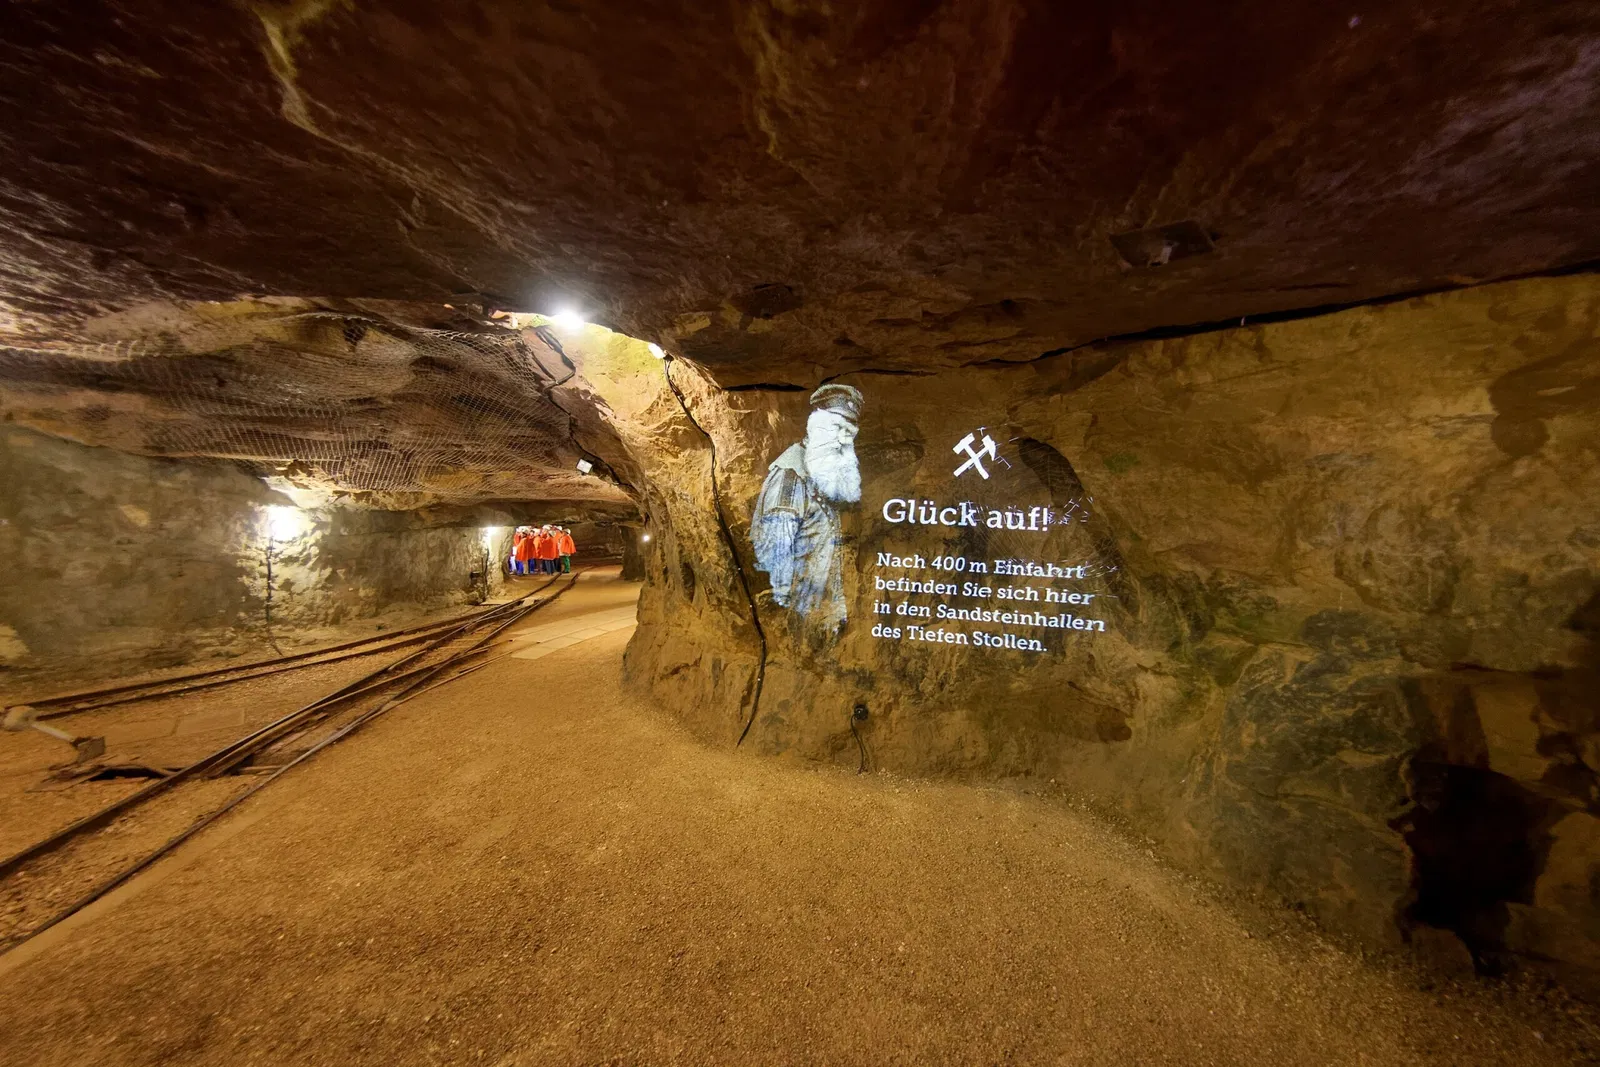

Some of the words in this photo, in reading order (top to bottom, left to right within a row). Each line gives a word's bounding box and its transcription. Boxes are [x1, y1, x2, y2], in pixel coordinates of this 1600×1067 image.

[882, 498, 977, 527] Glück
[986, 506, 1048, 532] auf!
[876, 552, 926, 569] Nach
[931, 555, 966, 572] 400
[968, 561, 988, 573] m
[993, 559, 1084, 579] Einfahrt
[874, 576, 958, 595] befinden
[962, 582, 992, 598] Sie
[996, 585, 1040, 601] sich
[1044, 587, 1095, 605] hier
[873, 599, 891, 614] in
[896, 602, 931, 617] den
[936, 604, 1105, 632] Sandsteinhallen
[871, 623, 902, 639] des
[907, 625, 969, 645] Tiefen
[973, 631, 1047, 652] Stollen.
